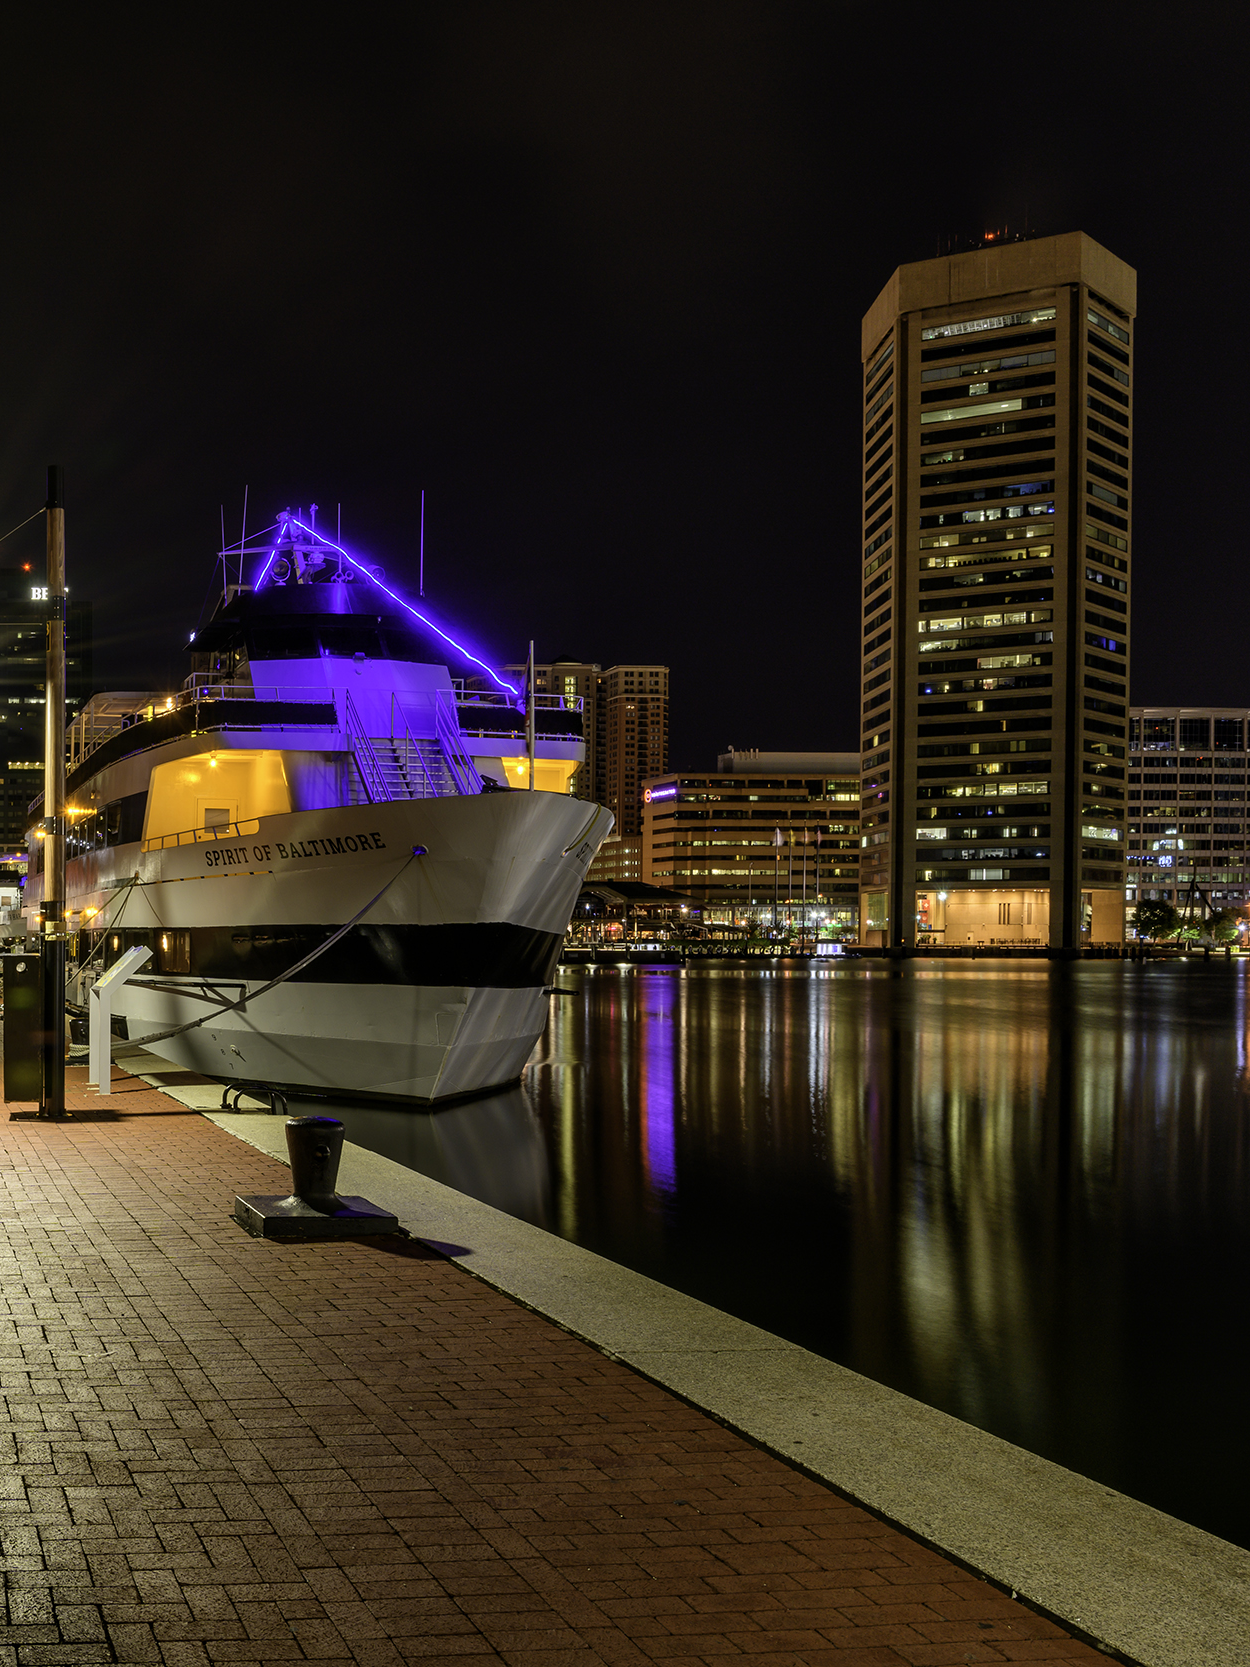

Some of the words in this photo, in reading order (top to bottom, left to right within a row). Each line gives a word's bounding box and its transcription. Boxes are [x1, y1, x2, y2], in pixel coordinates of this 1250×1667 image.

[205, 847, 250, 867] SPIRIT
[253, 844, 272, 862] OF
[275, 832, 387, 859] BALTIMORE
